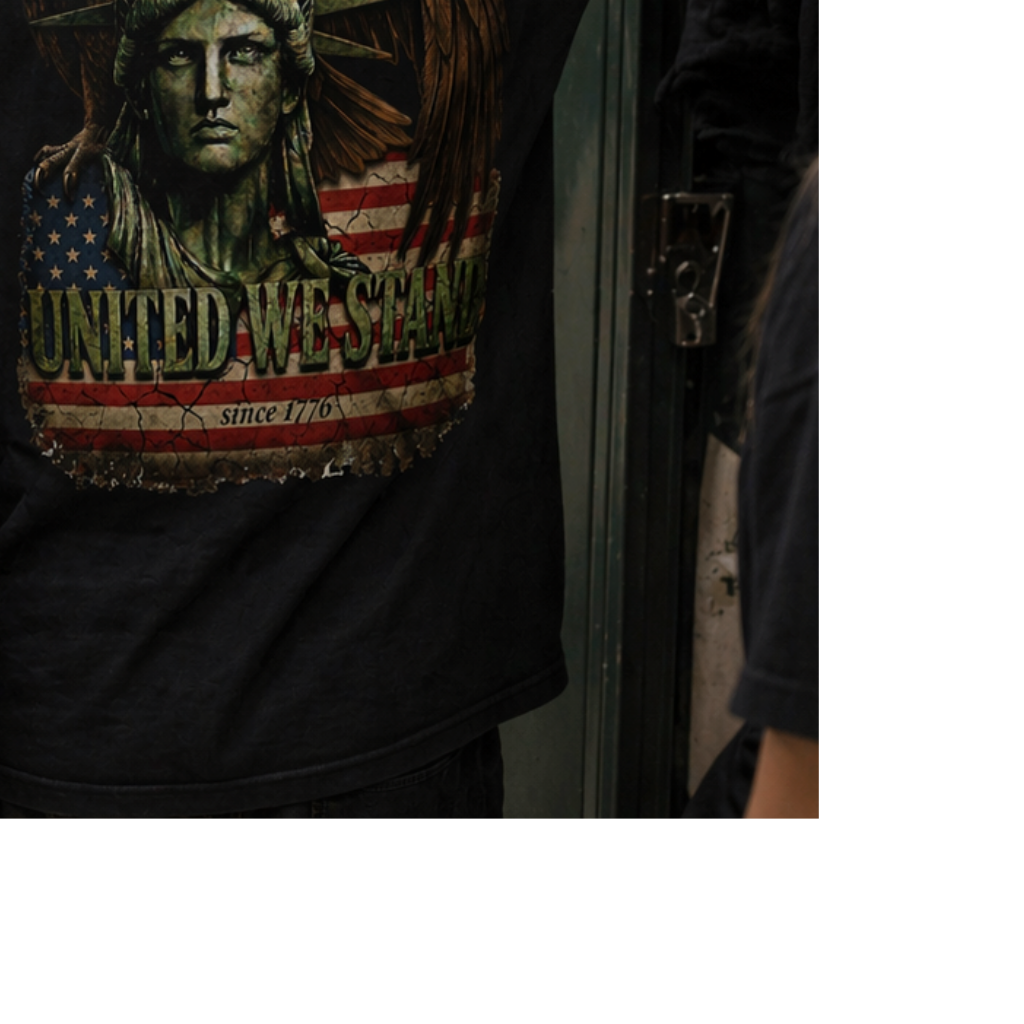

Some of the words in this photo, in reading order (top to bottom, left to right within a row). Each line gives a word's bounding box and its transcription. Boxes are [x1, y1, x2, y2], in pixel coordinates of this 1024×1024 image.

[27, 287, 232, 378] UNITED
[244, 278, 330, 372] WE
[220, 401, 277, 426] since
[283, 395, 332, 425] 1776
